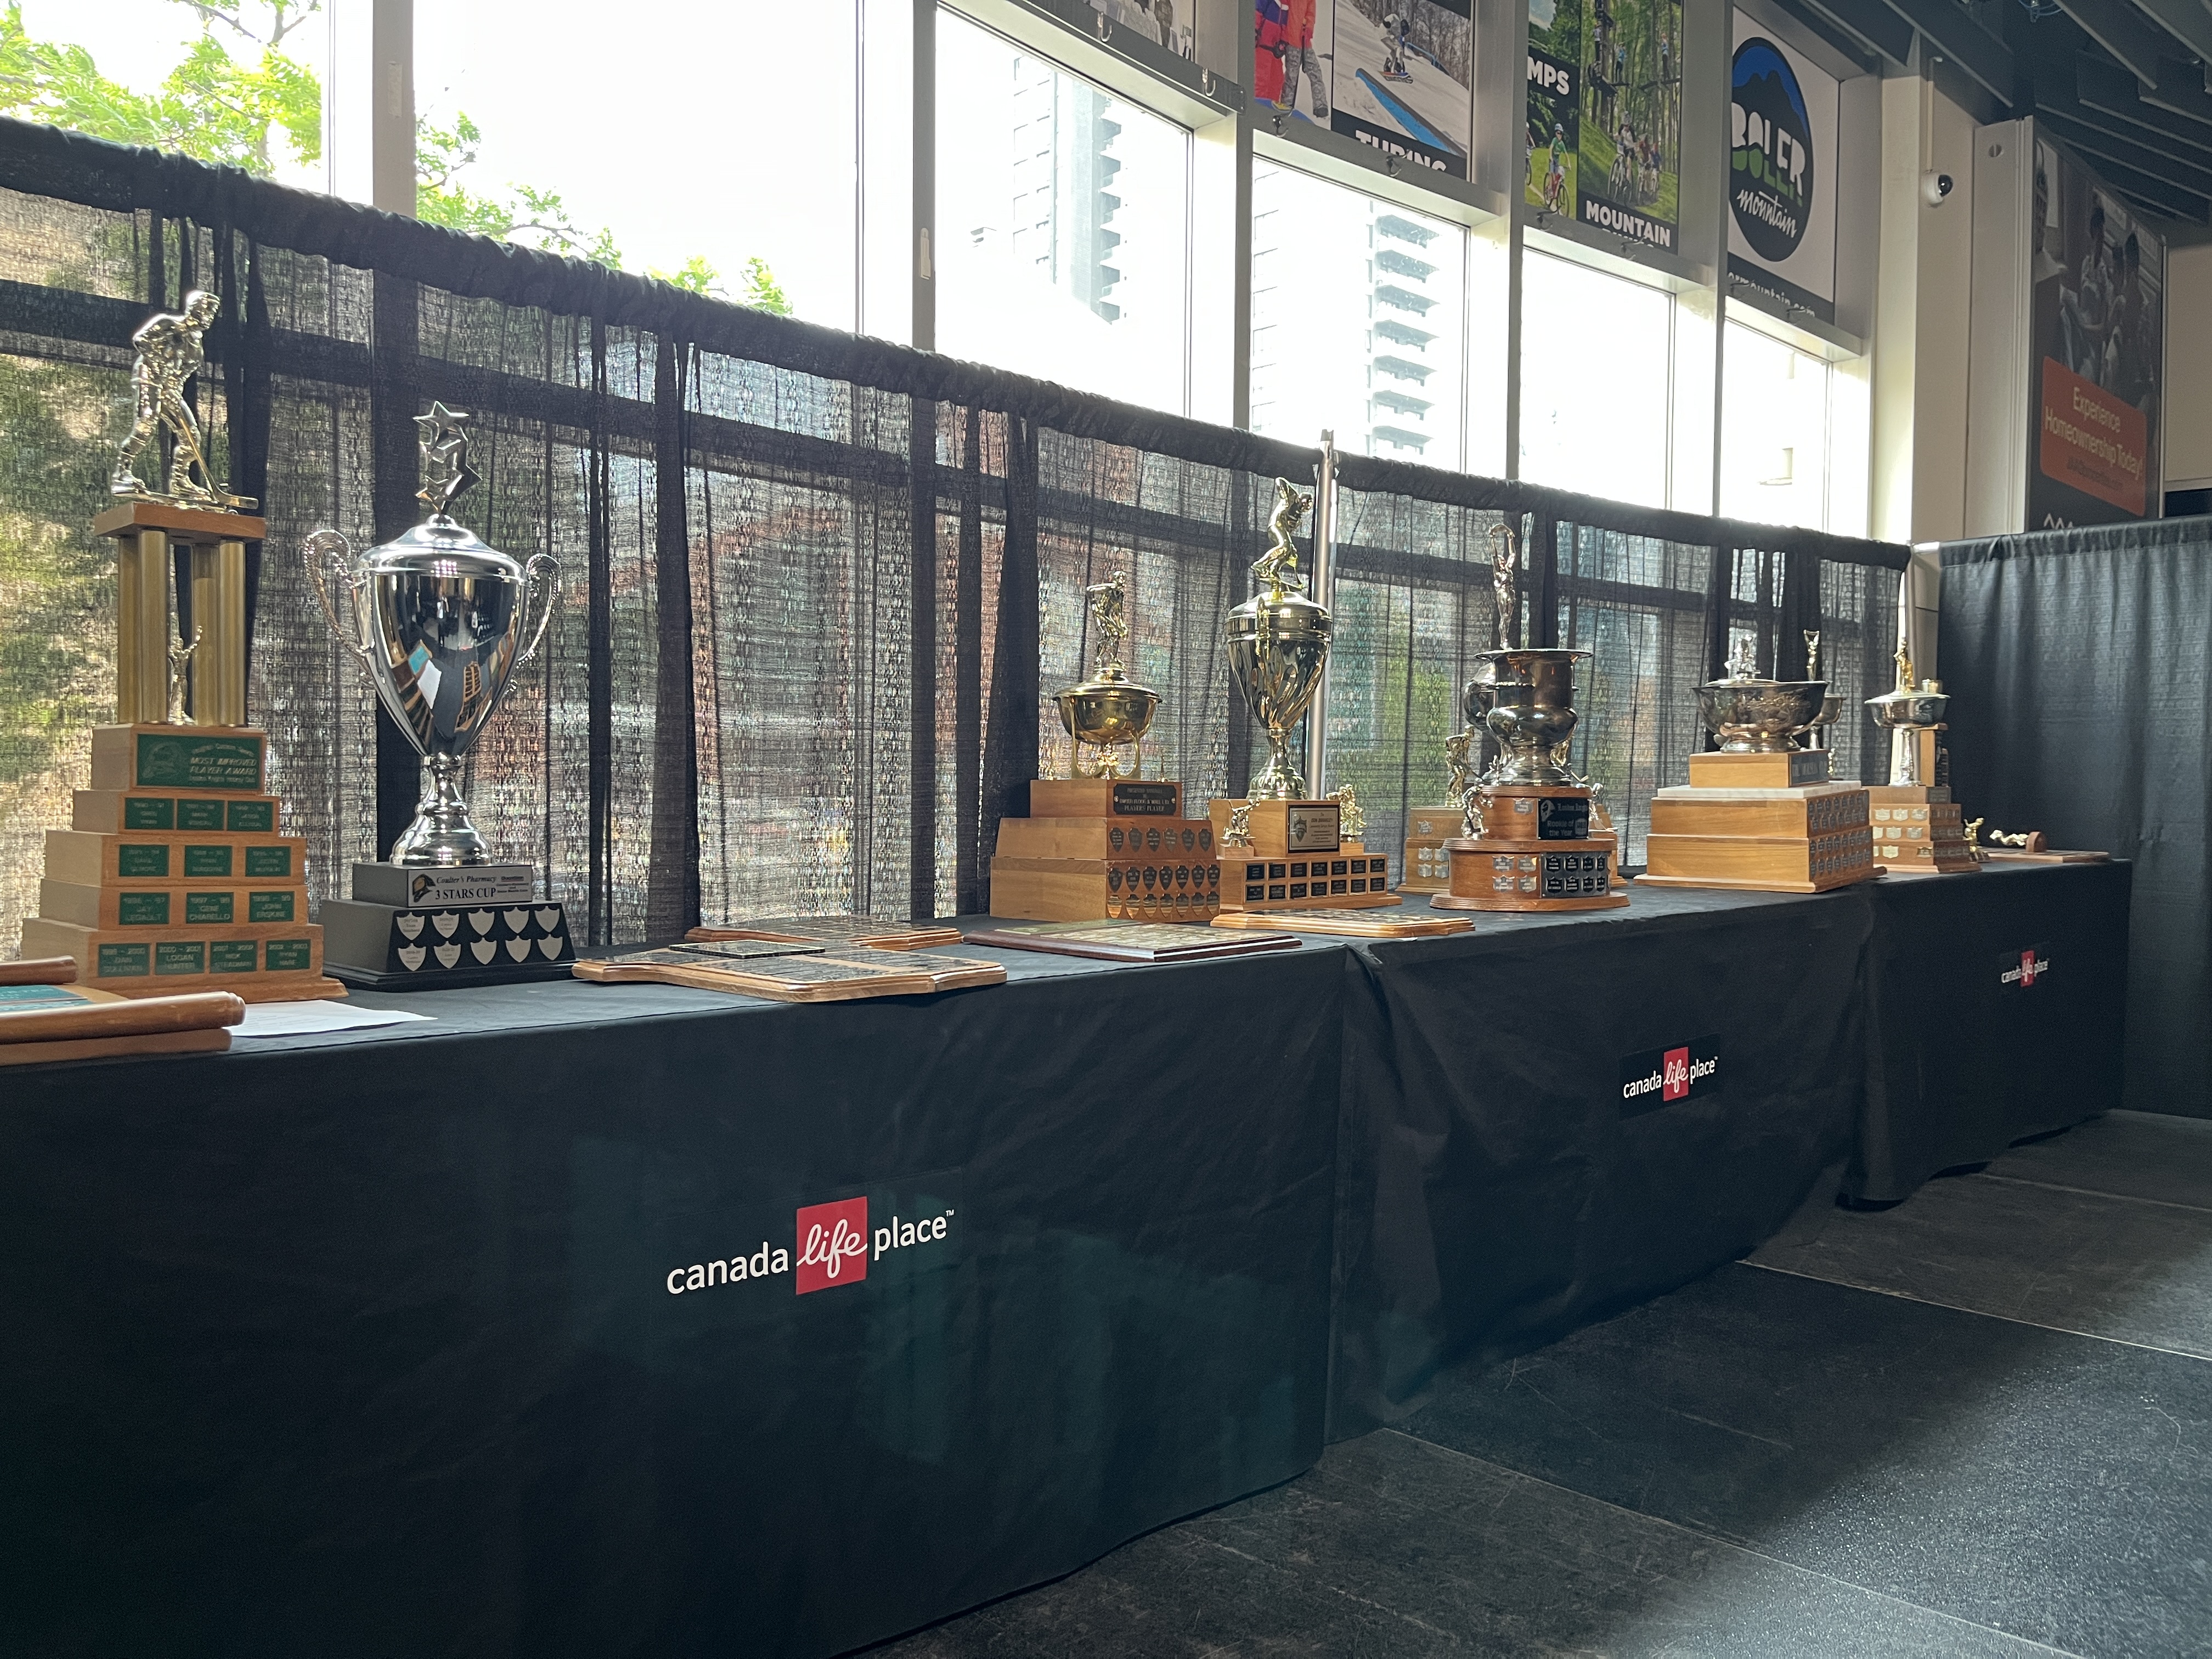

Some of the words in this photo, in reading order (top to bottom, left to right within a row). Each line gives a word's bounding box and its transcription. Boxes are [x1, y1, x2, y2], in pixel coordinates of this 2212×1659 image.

[1586, 200, 1671, 247] MOUNTAIN
[1737, 189, 1797, 238] mountain
[2073, 387, 2121, 433] Experience
[2045, 405, 2117, 467] Homeownership
[189, 766, 223, 774] PLAYER
[217, 758, 257, 766] IMPROVED
[435, 890, 440, 900] 3
[443, 888, 475, 900] STARS
[476, 887, 496, 898] CUP
[466, 875, 497, 883] Pharmacy
[1623, 1070, 1662, 1098] canada
[1663, 1059, 1688, 1093] life
[1690, 1058, 1716, 1085] place
[667, 1242, 789, 1294] canada
[797, 1218, 868, 1279] life
[874, 1216, 947, 1261] place
